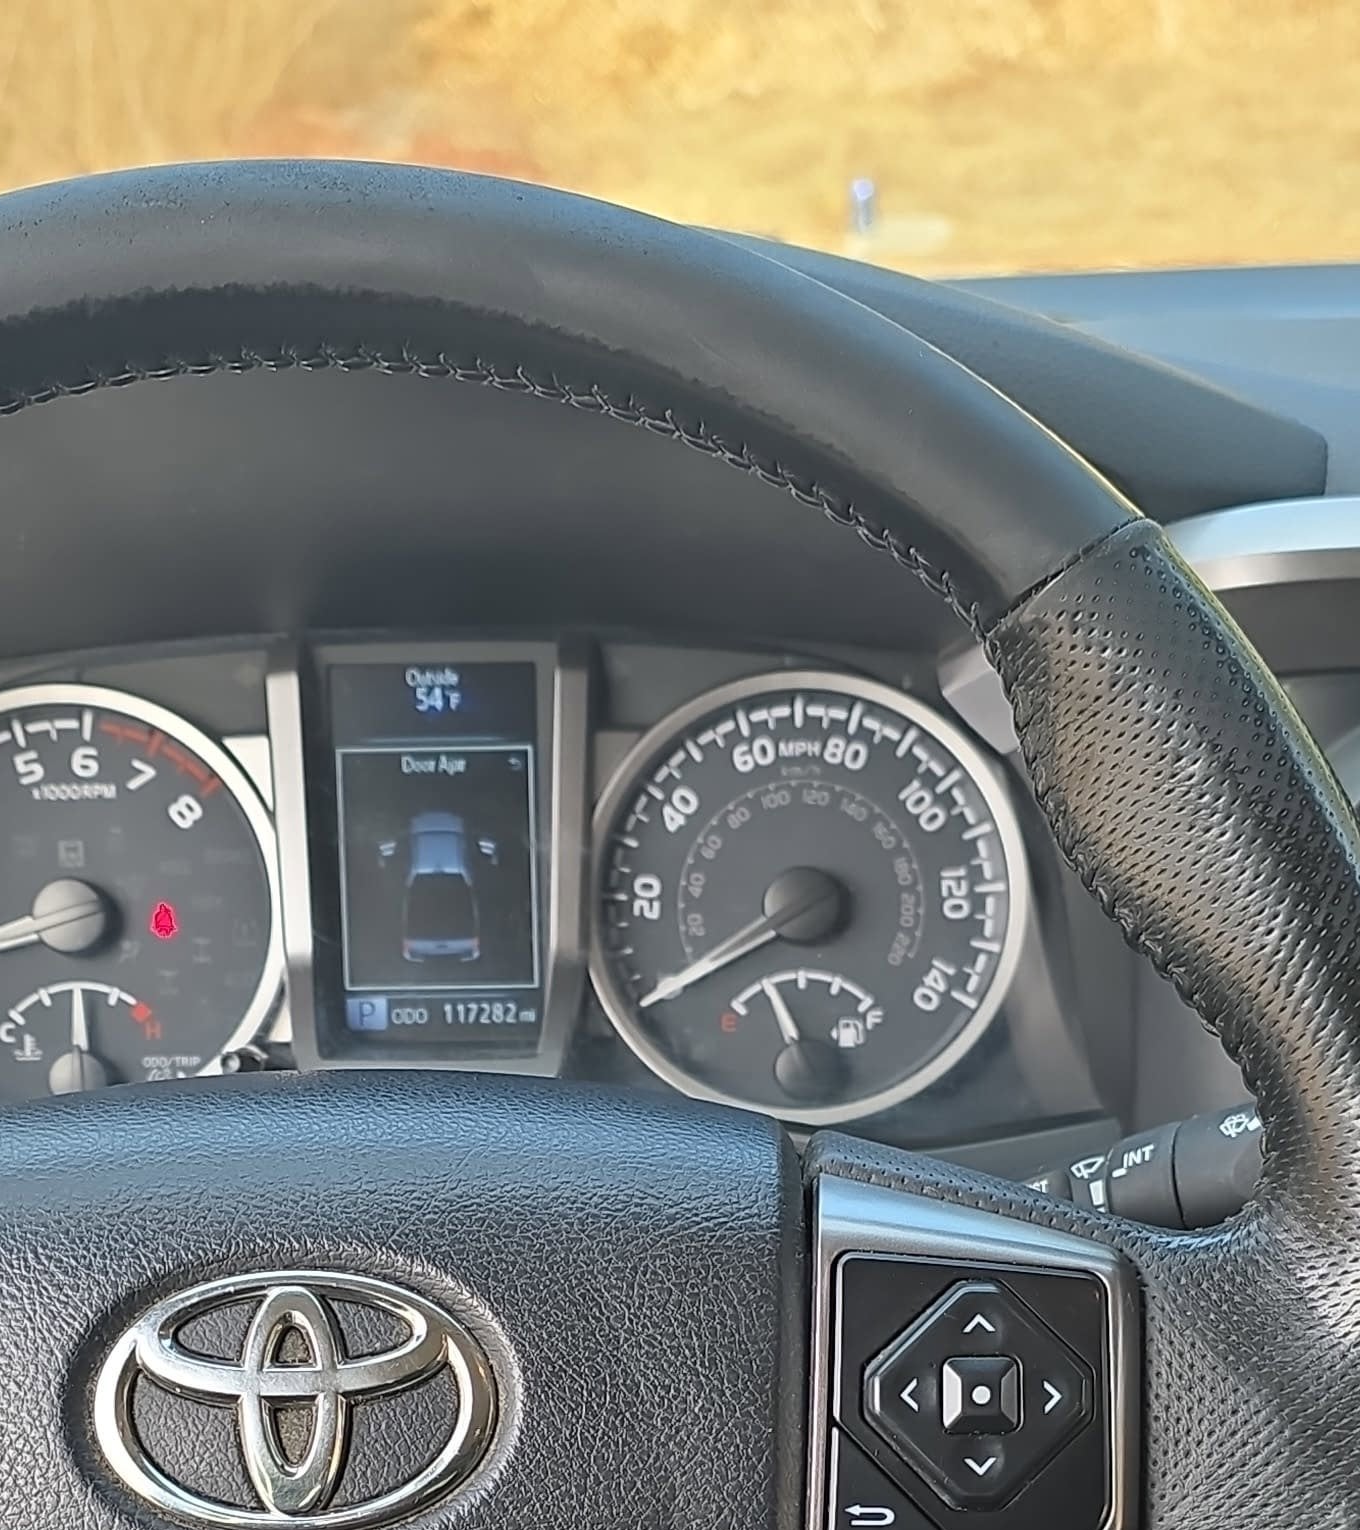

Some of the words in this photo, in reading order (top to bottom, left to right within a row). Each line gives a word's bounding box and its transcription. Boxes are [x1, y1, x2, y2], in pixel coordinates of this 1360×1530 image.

[70, 747, 98, 778] 6
[731, 736, 776, 774] 60
[778, 740, 821, 758] MPH
[822, 736, 868, 771] 80
[14, 751, 44, 785] 5
[126, 760, 156, 790] 7
[168, 795, 203, 829] 8
[661, 785, 698, 834] 40
[760, 790, 792, 811] 100
[801, 789, 830, 807] 120
[898, 779, 946, 833] 100
[726, 807, 752, 831] 80
[700, 835, 723, 860] 60
[632, 873, 662, 920] 20
[687, 872, 706, 900] 40
[939, 868, 972, 921] 120
[686, 912, 706, 938] 20
[912, 959, 956, 1012] 140
[392, 1008, 428, 1025] ODO
[443, 1003, 517, 1025] 117282
[145, 1022, 161, 1040] H
[1123, 1145, 1154, 1168] INT
